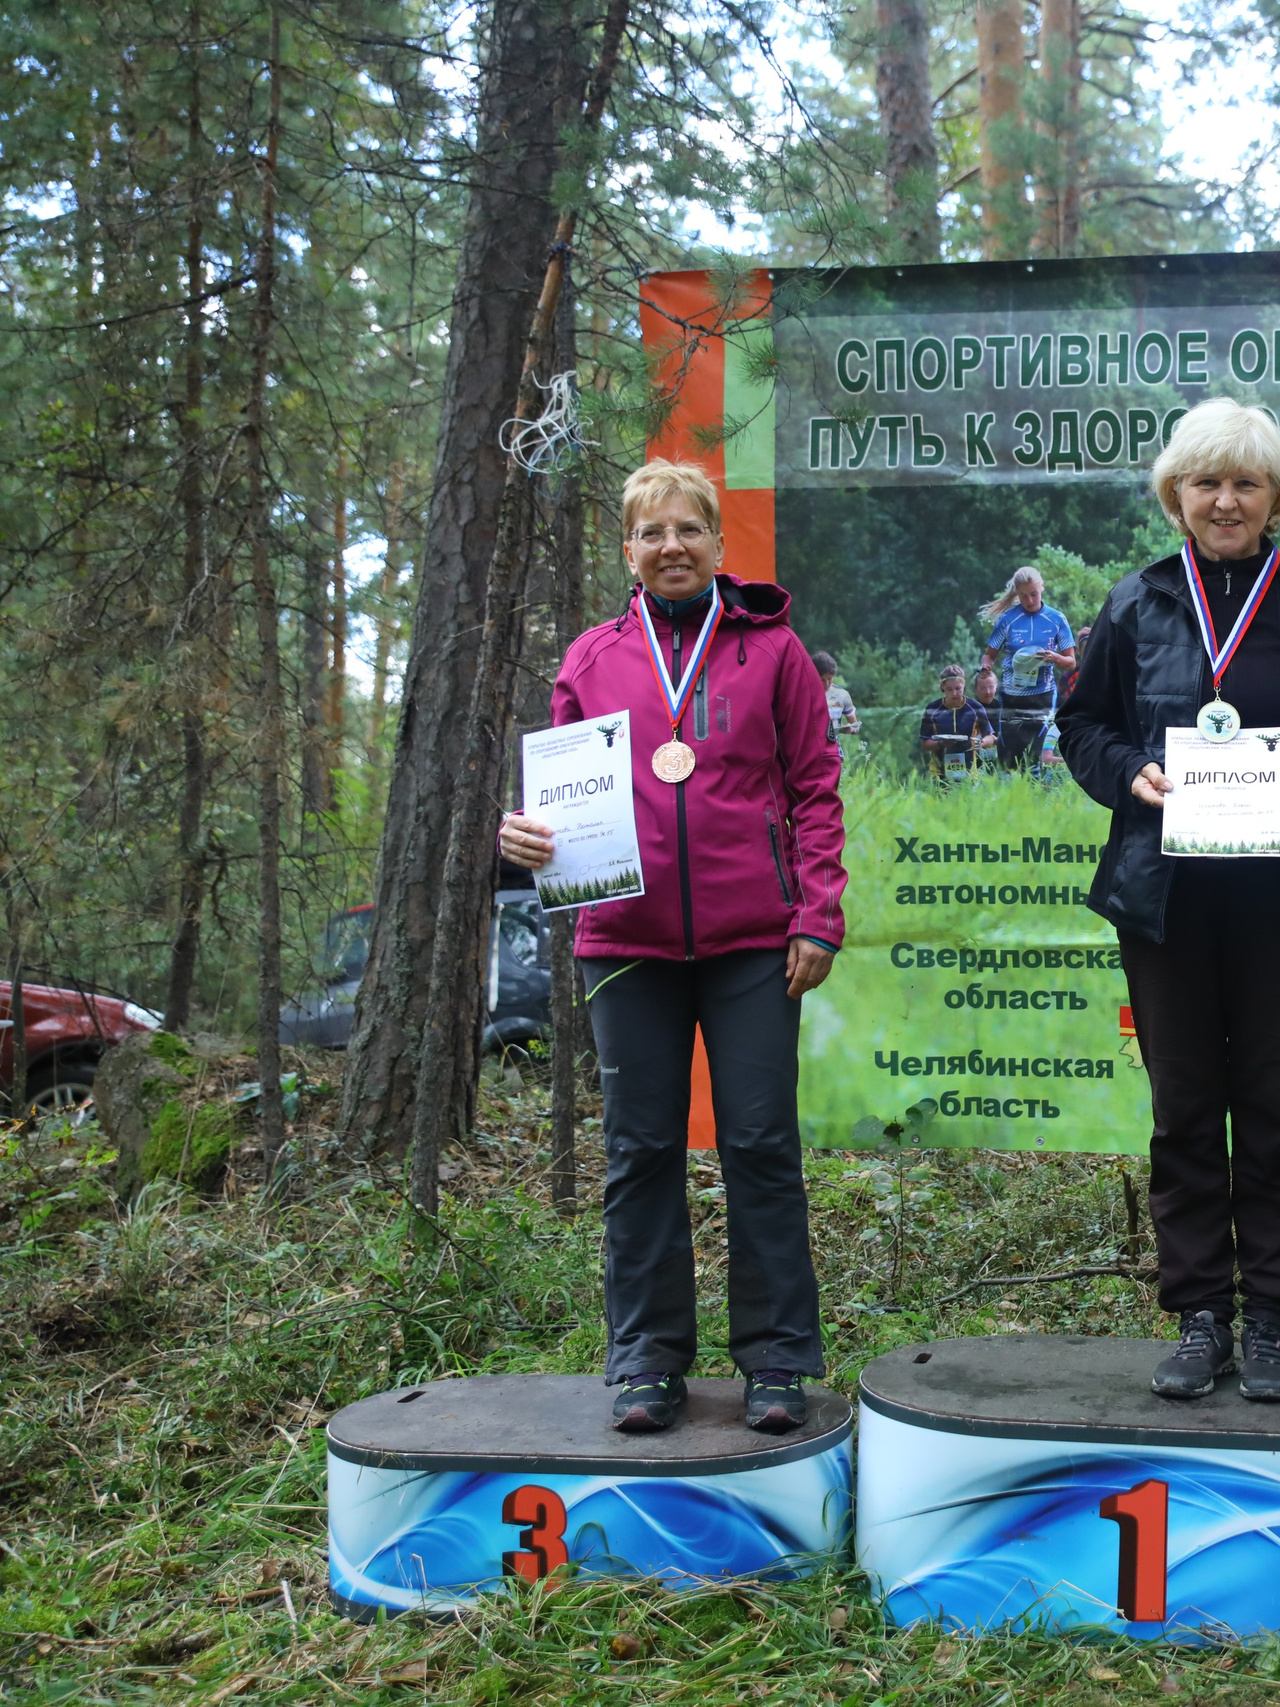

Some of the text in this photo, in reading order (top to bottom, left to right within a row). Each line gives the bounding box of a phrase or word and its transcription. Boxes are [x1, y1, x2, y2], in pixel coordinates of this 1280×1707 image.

[836, 330, 1209, 393] СПОРТИВНОЕ
[808, 413, 946, 470] ПУТЬ
[965, 411, 997, 467] К
[539, 774, 615, 807] ДИПЛОМ
[1184, 771, 1276, 786] ДИПЛОМ
[890, 942, 1124, 974] Свердловска
[944, 983, 1088, 1011] область
[874, 1049, 1114, 1079] Челябинская
[502, 1484, 569, 1595] 3
[1099, 1478, 1169, 1622] 1
